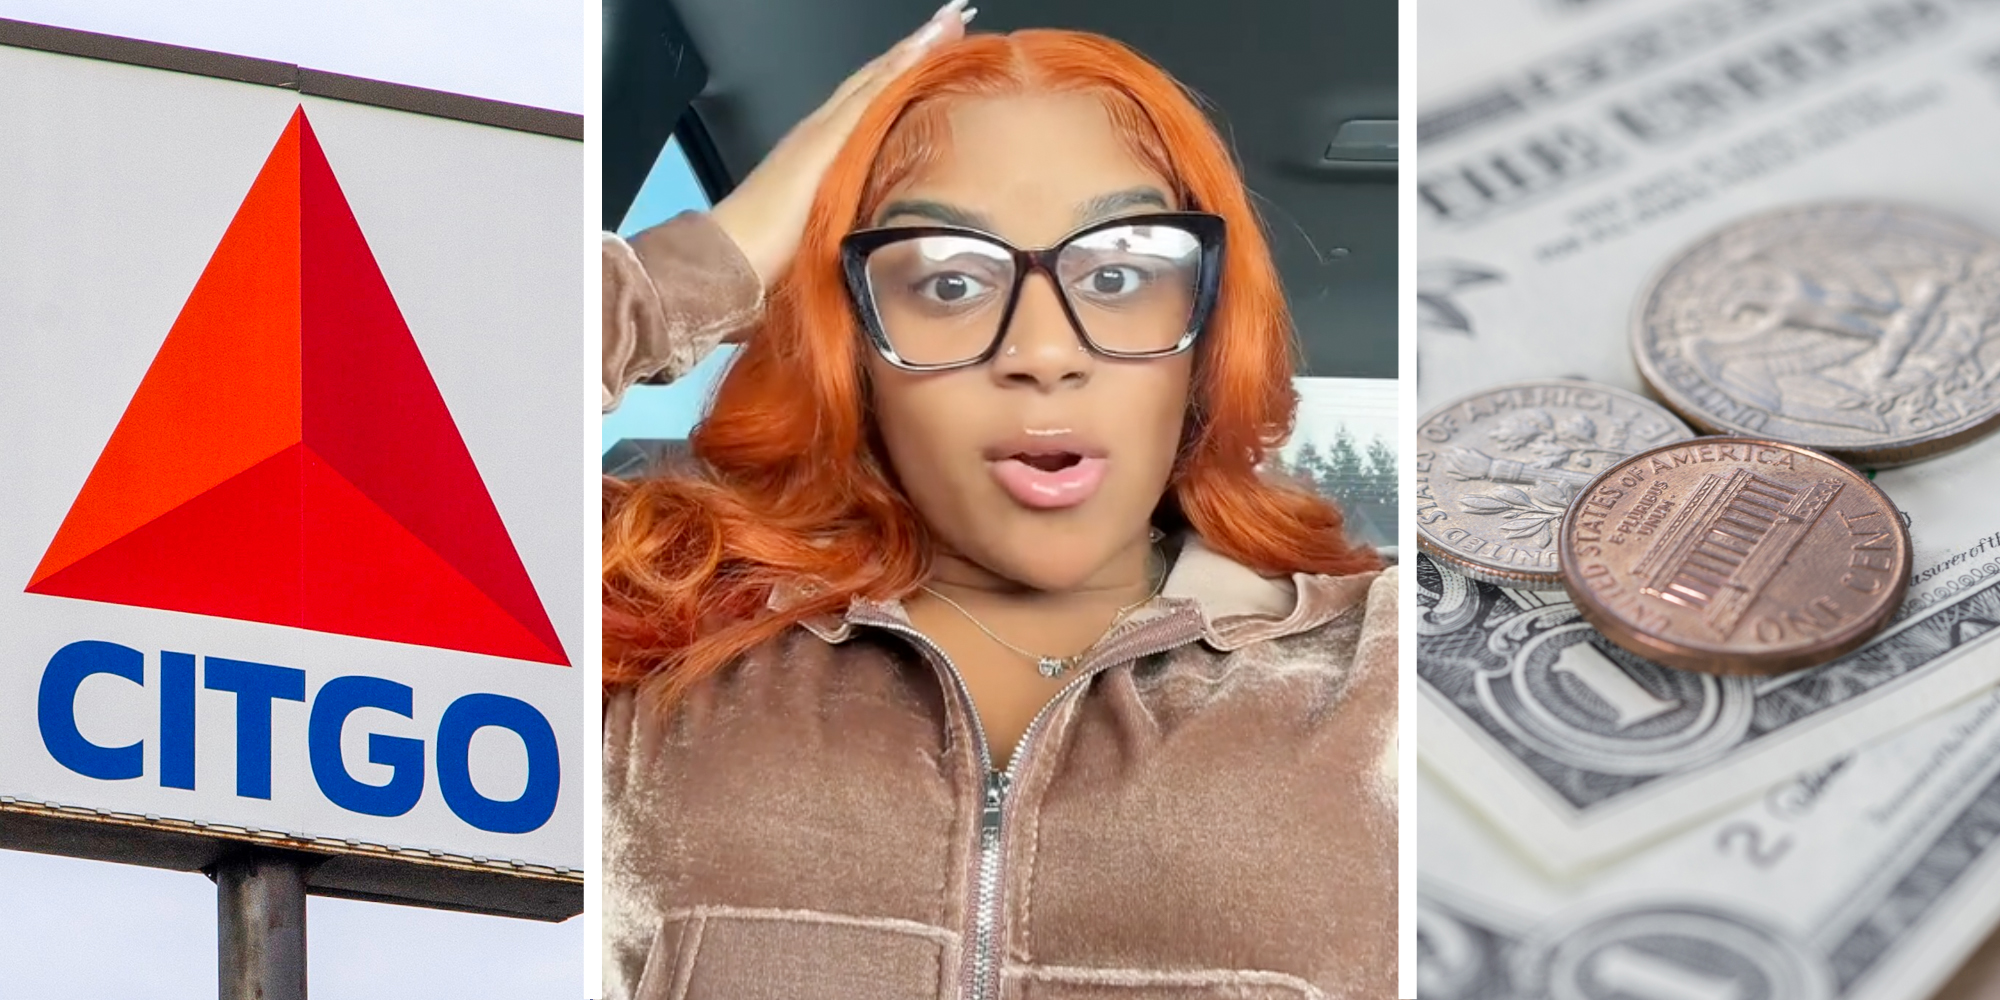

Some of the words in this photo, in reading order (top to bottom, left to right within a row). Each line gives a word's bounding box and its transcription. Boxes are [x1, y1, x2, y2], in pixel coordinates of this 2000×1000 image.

[1573, 486, 1624, 557] STATES
[1620, 466, 1645, 488] OF
[1649, 444, 1795, 475] AMERICA
[1756, 597, 1844, 643] ONE
[1838, 510, 1894, 594] CENT
[1909, 552, 1967, 587] asurer
[38, 640, 561, 834] CITGO
